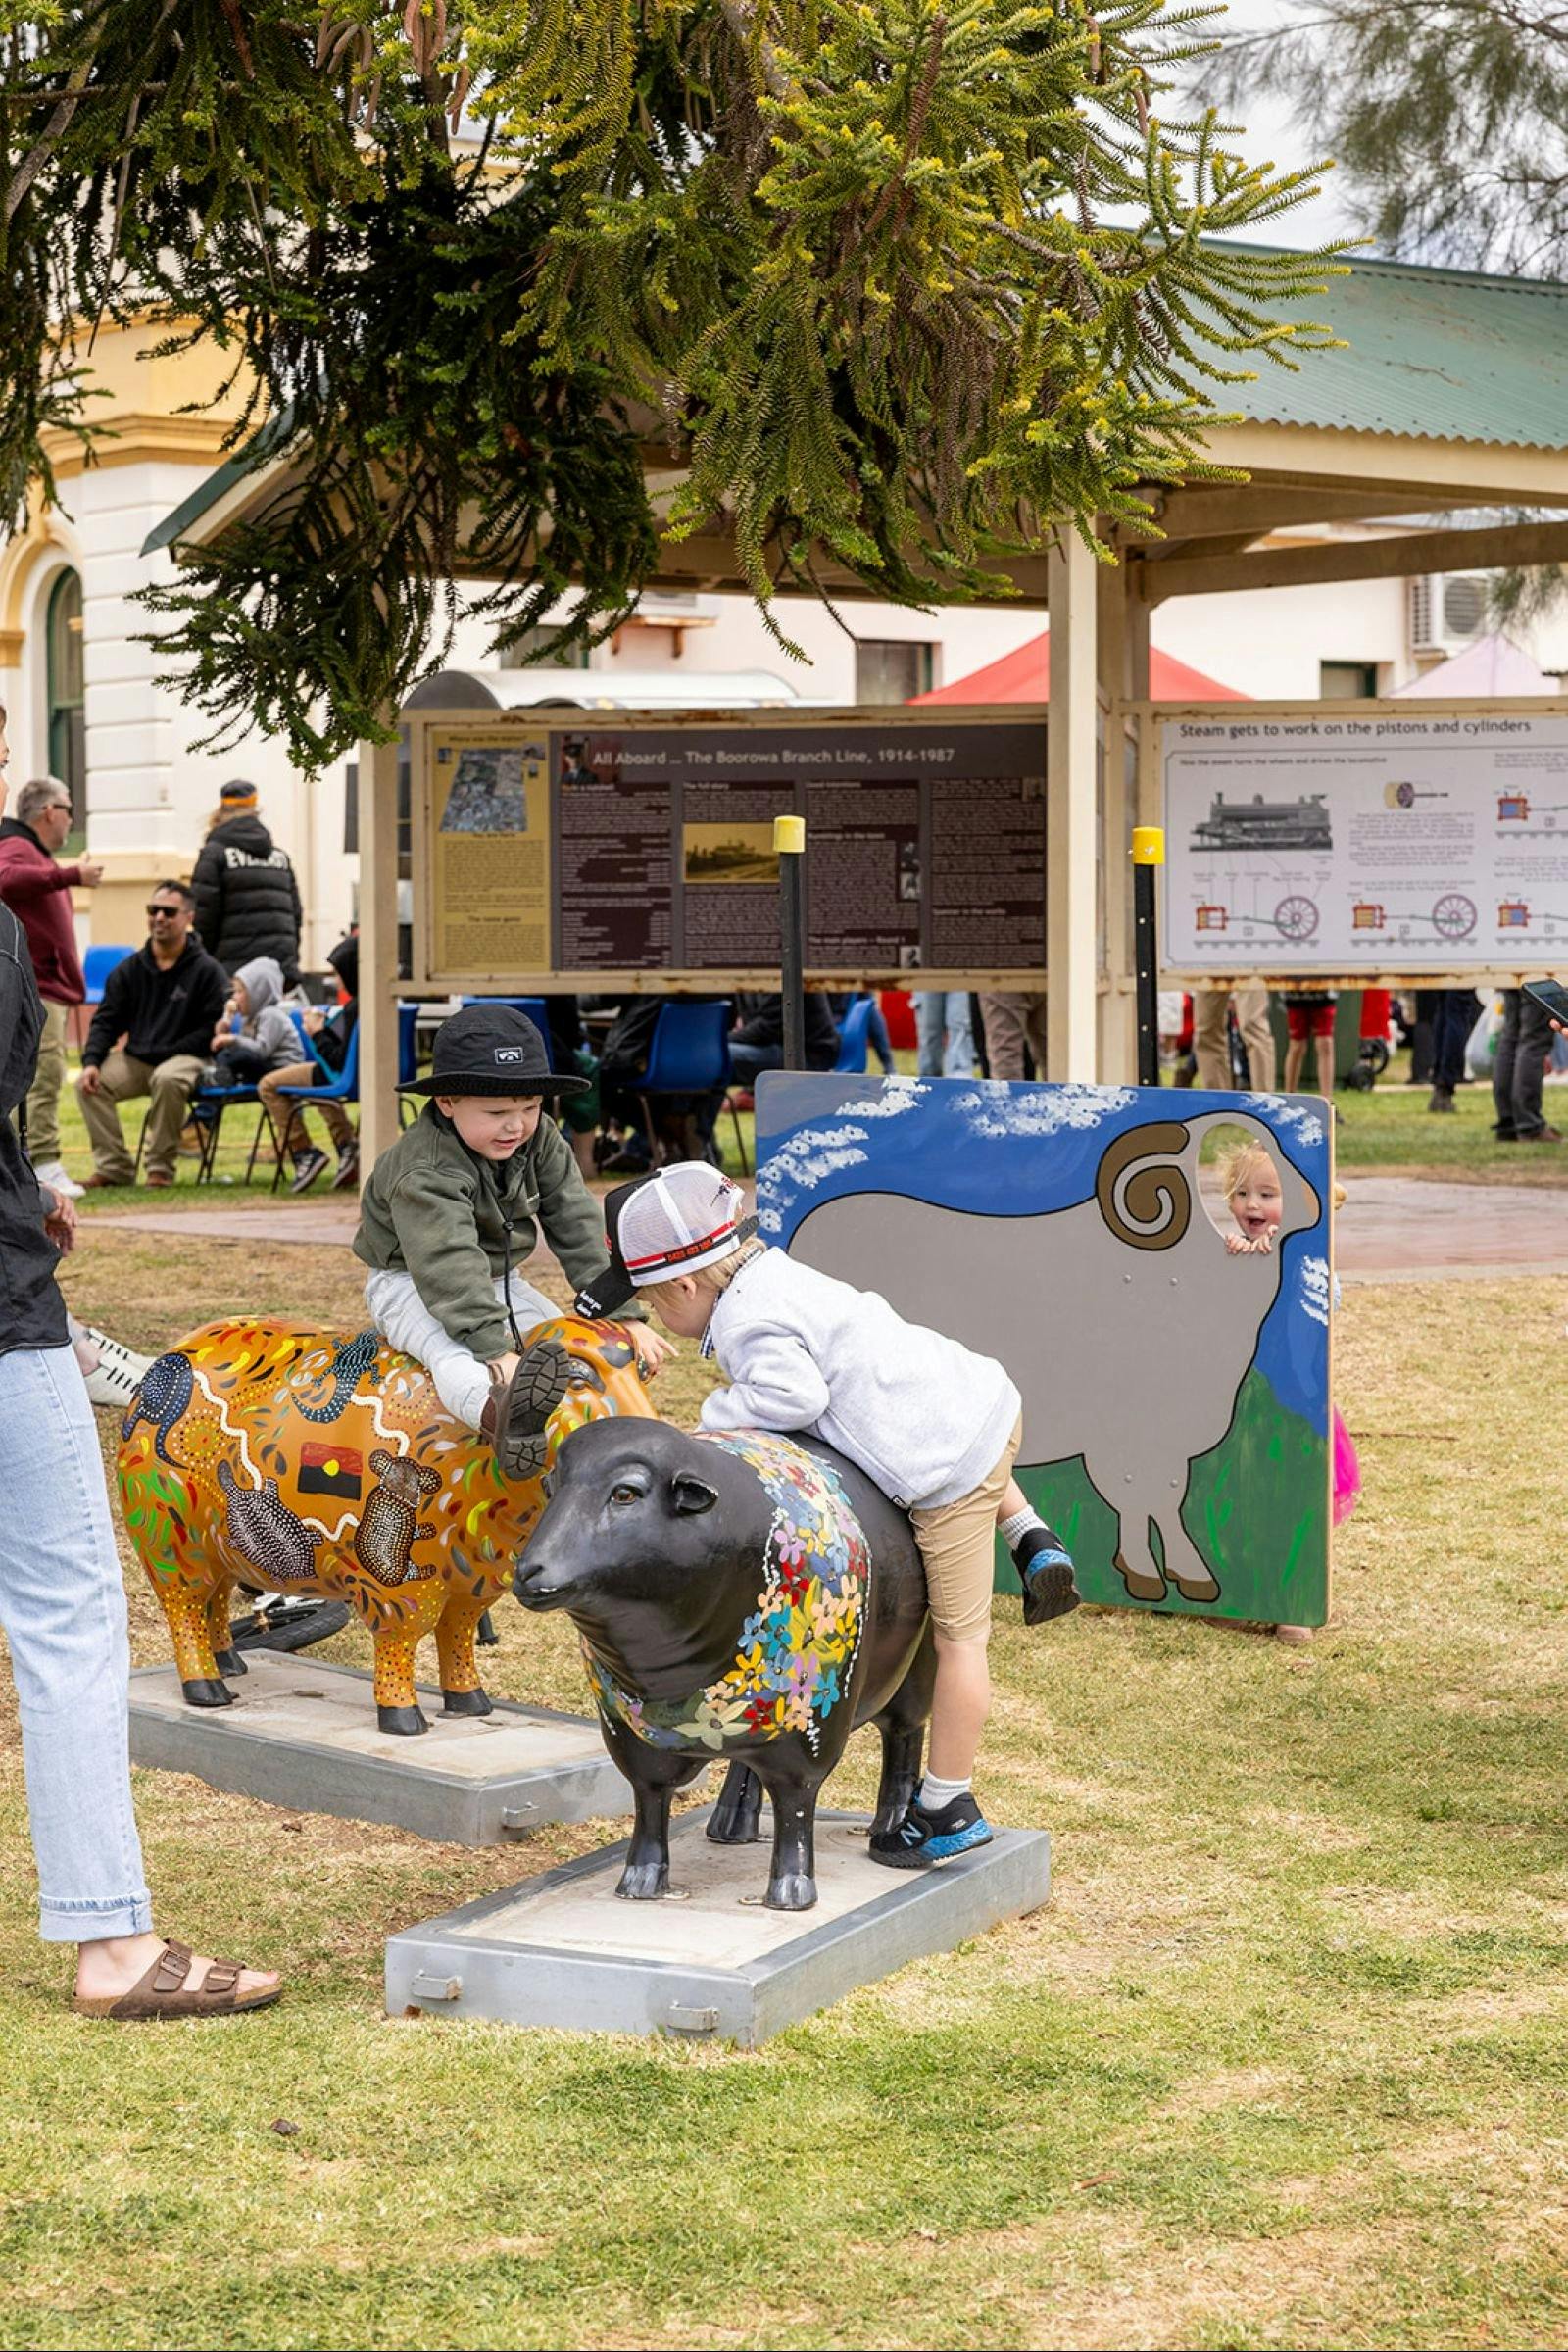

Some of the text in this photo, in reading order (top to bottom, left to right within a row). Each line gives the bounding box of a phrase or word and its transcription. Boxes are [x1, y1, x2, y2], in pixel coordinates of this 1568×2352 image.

[1179, 719, 1532, 740] Steam gets to work on the pistons and cylinders
[593, 751, 612, 765] All
[614, 751, 666, 765] Aboard
[685, 750, 713, 764] The
[715, 750, 779, 764] Boorowa
[782, 748, 832, 764] Branch
[835, 749, 873, 765] Line,
[878, 747, 956, 763] 1914-1987
